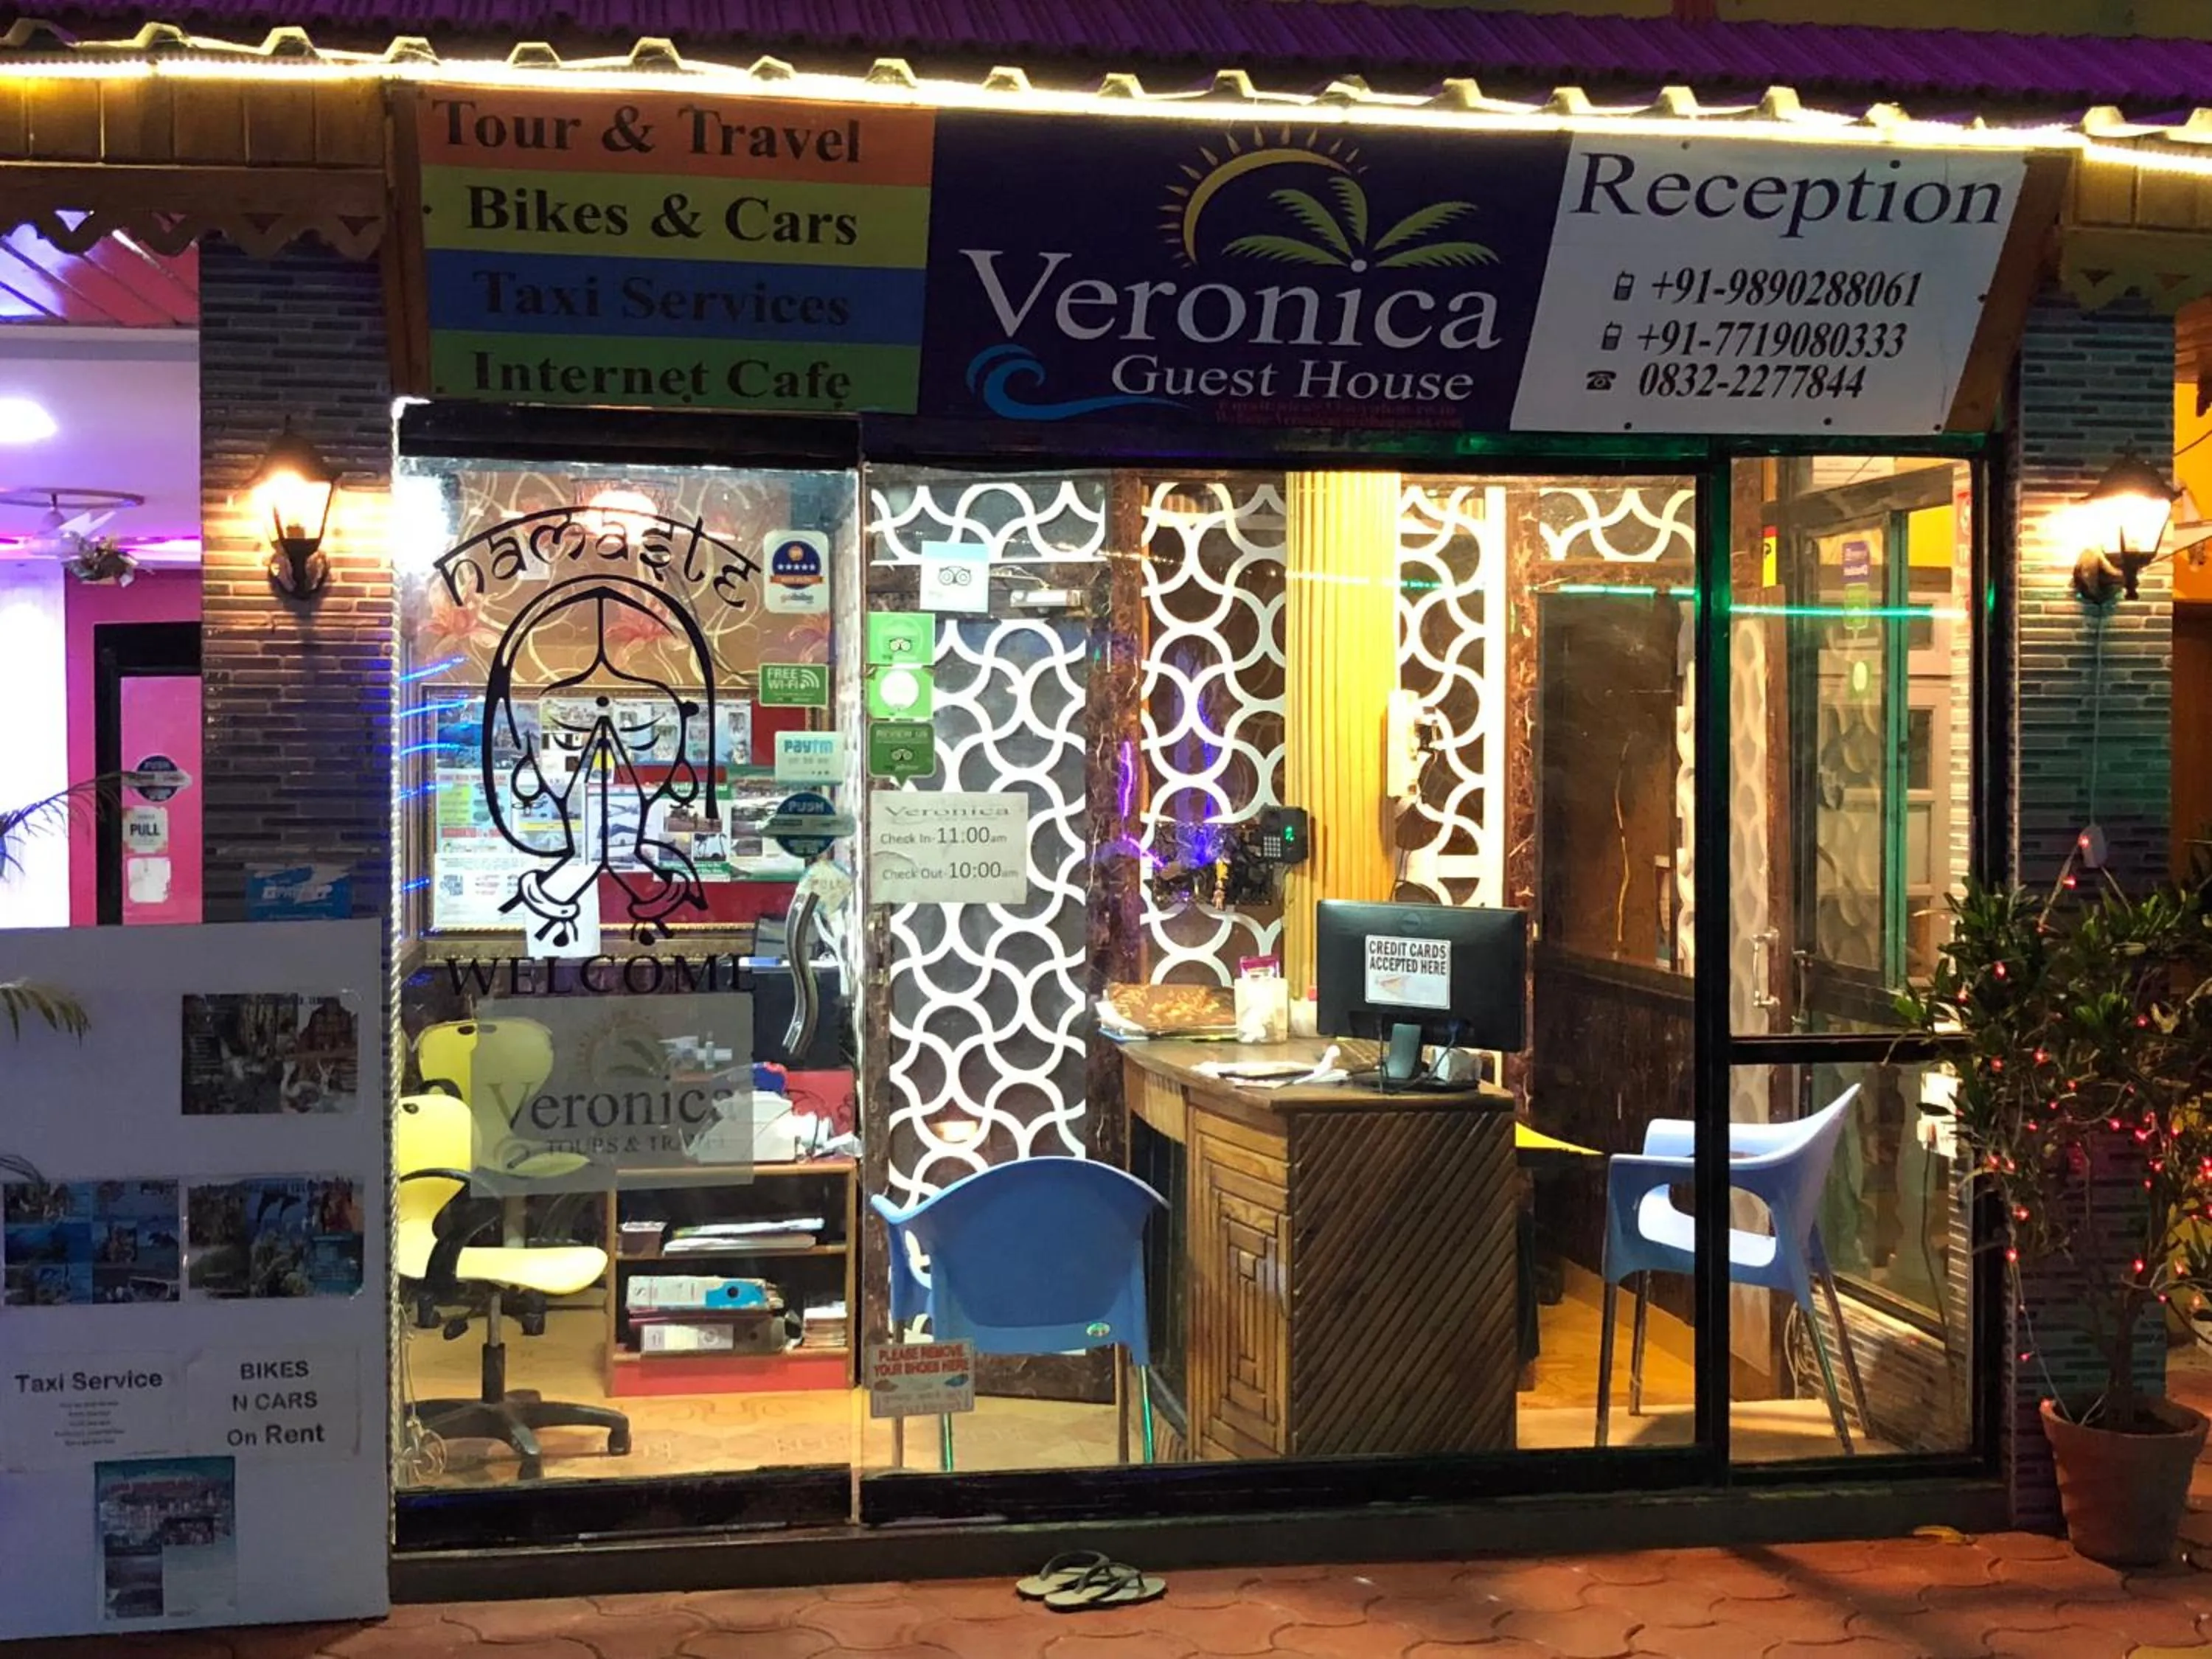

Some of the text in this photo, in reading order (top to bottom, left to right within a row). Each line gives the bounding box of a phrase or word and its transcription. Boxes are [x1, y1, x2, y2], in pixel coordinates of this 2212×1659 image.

[432, 99, 860, 163] Tour & Travel
[1569, 152, 2003, 239] Reception
[467, 185, 858, 246] Bikes & Cars
[473, 270, 849, 326] Taxi Services
[959, 248, 1503, 351] Veronica
[1651, 267, 1922, 307] +91-9890288061
[1637, 320, 1908, 359] +91-7719080333
[473, 351, 852, 401] Internet Cafe
[1112, 354, 1474, 401] Guest House
[1638, 363, 1867, 399] 0832-2277844
[767, 667, 797, 679] FREE
[130, 824, 161, 836] PULL
[880, 833, 915, 844] Check
[882, 869, 917, 880] Check
[1369, 940, 1446, 959] CREDIT CARDS
[1369, 957, 1446, 975] ACCEPTED HERE
[444, 953, 756, 995] WELCOME
[15, 1370, 163, 1394] Taxi Service
[240, 1360, 310, 1380] BIKES
[233, 1391, 318, 1411] N CARS
[226, 1425, 325, 1447] On Rent
